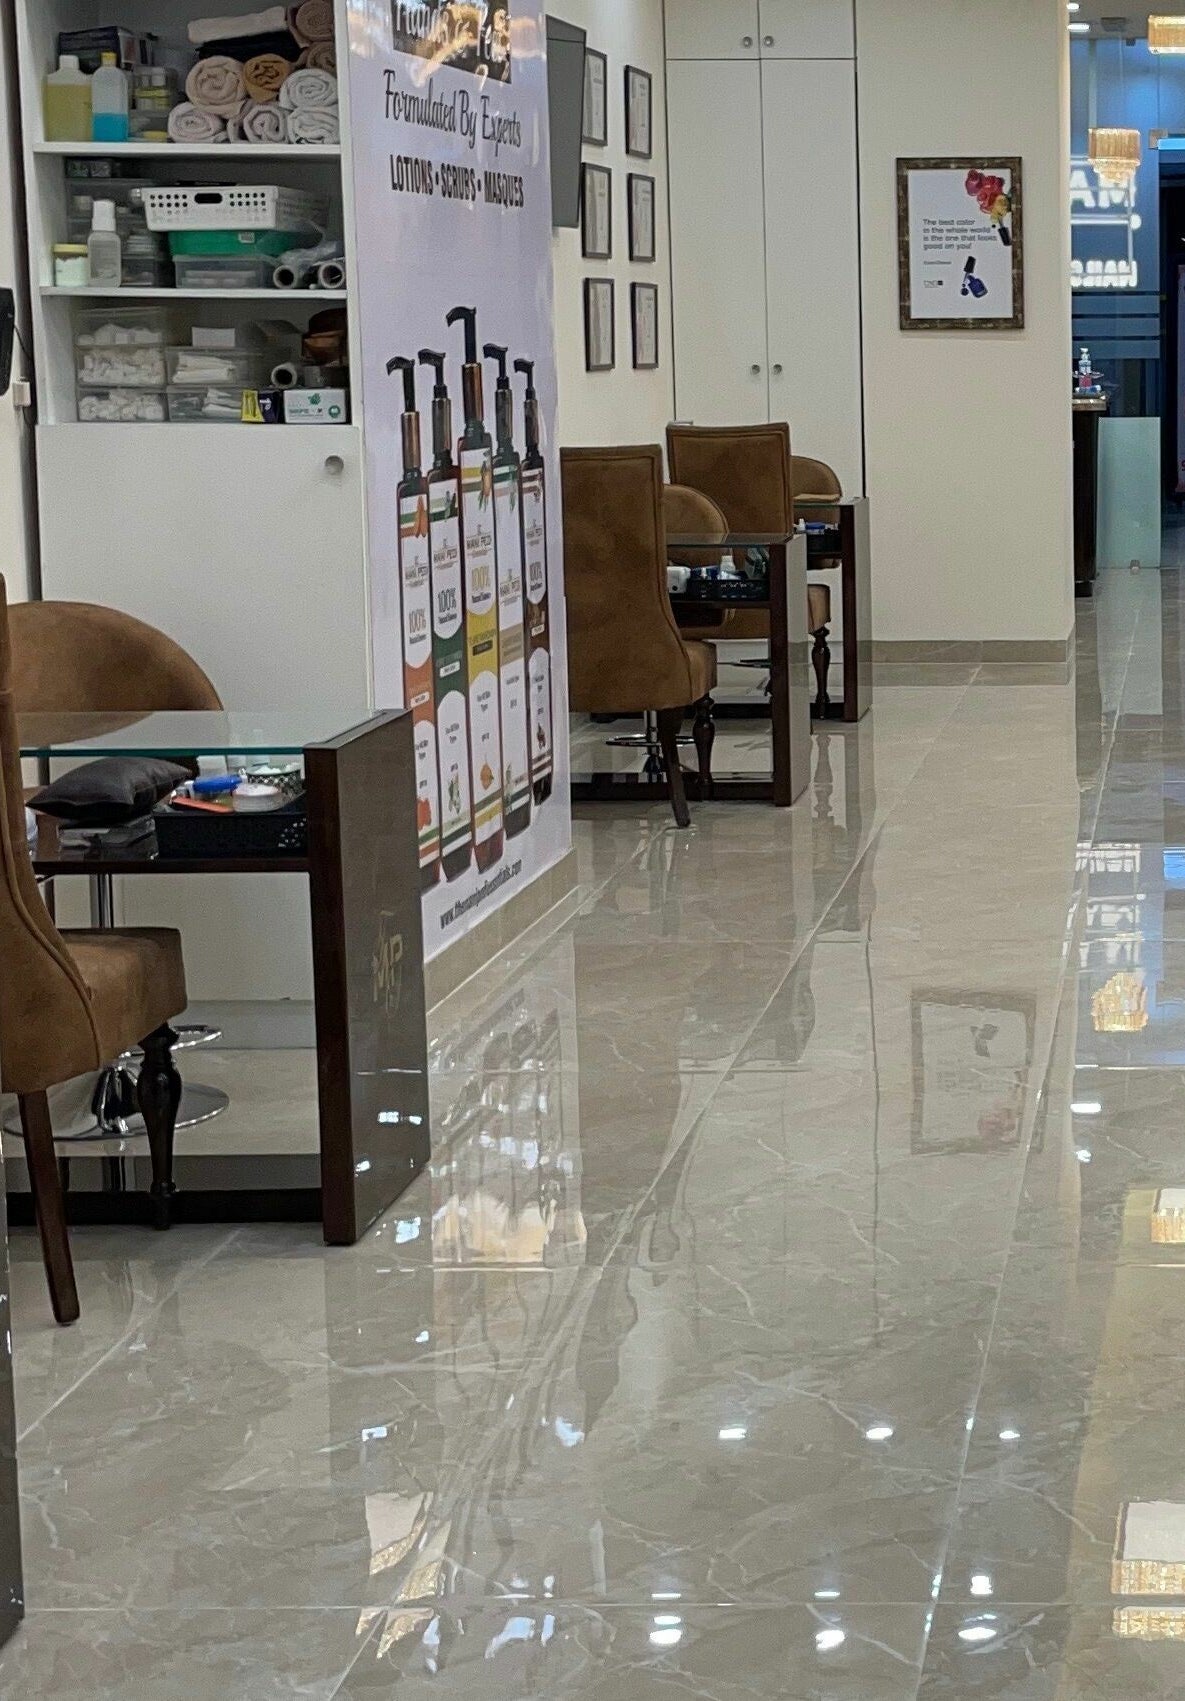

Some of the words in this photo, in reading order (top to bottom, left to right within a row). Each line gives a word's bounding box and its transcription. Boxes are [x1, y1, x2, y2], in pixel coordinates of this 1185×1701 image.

[383, 69, 457, 133] Formulated
[459, 90, 477, 149] By
[481, 95, 521, 157] Experts
[390, 154, 434, 195] LOTIONS
[441, 163, 476, 201] SCRUBS
[484, 171, 524, 208] MASQUES
